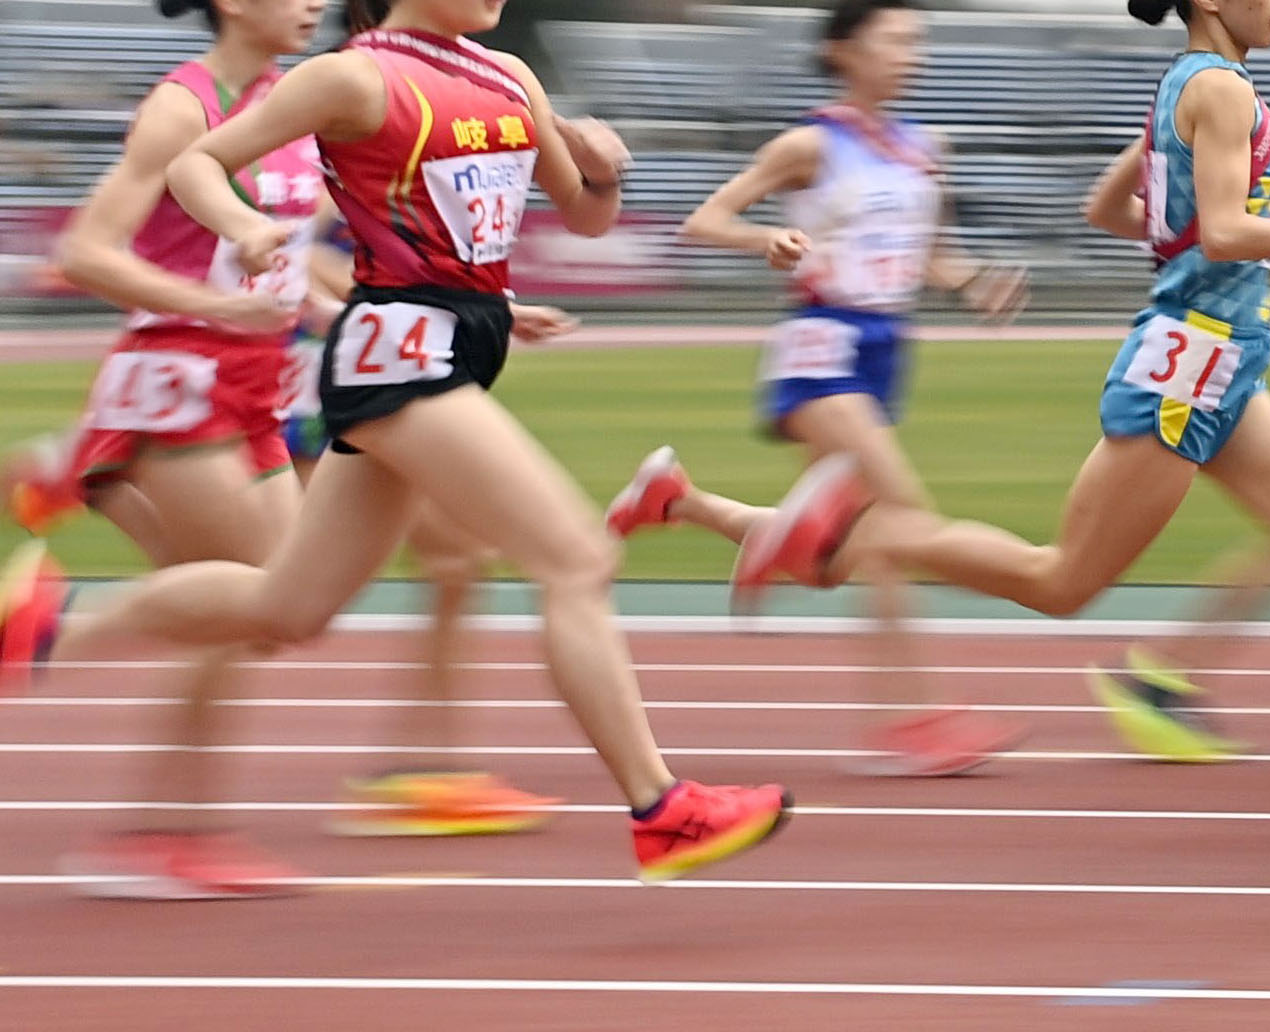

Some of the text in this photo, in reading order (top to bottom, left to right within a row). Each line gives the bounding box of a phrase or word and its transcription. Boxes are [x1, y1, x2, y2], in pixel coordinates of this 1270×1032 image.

[451, 115, 529, 150] 岐阜
[356, 312, 433, 374] 24
[1150, 331, 1223, 398] 31
